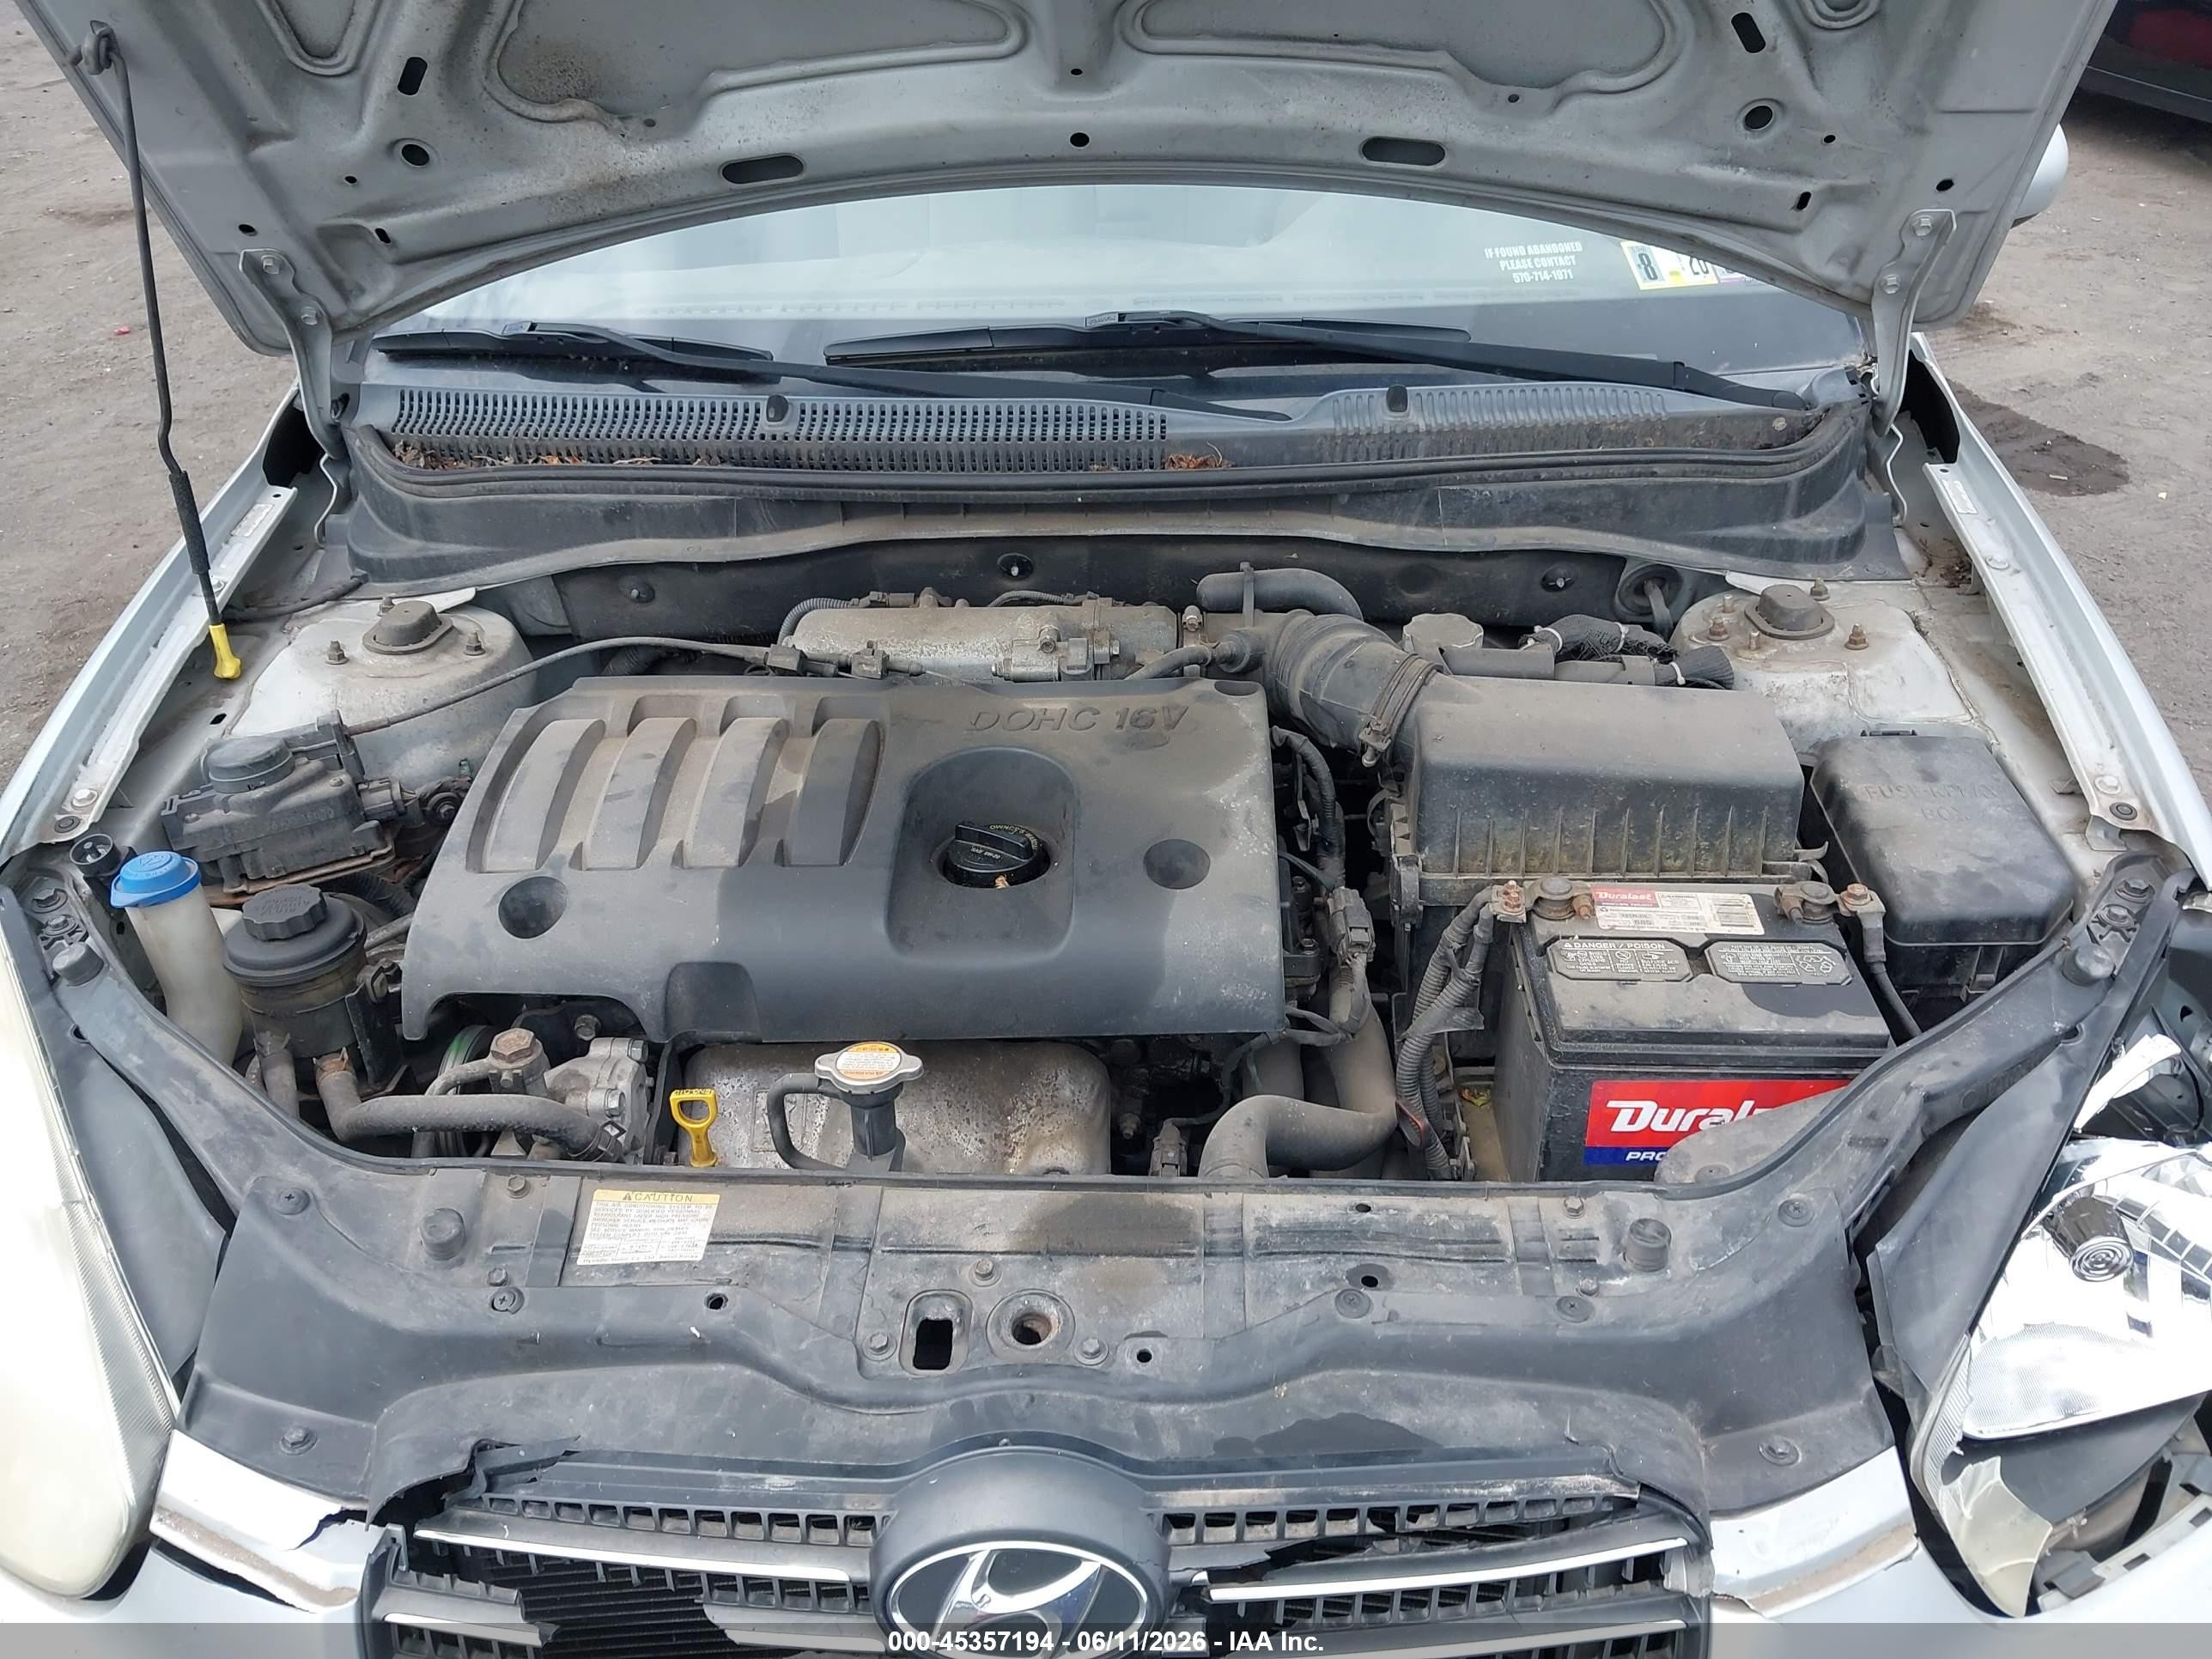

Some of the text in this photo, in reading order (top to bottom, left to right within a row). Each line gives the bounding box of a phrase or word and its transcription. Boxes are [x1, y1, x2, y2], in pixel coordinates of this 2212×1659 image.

[1484, 241, 1583, 258] IF FOUND ABANDONED
[1499, 255, 1576, 270] PLEASE CONTACT
[1638, 252, 1658, 281] 8
[1512, 269, 1574, 283] 570-714-1971
[970, 706, 1189, 731] DOHC 16V
[1596, 891, 1652, 901] Duralast
[1607, 1100, 1774, 1132] Dural
[635, 1194, 693, 1203] CAUTION
